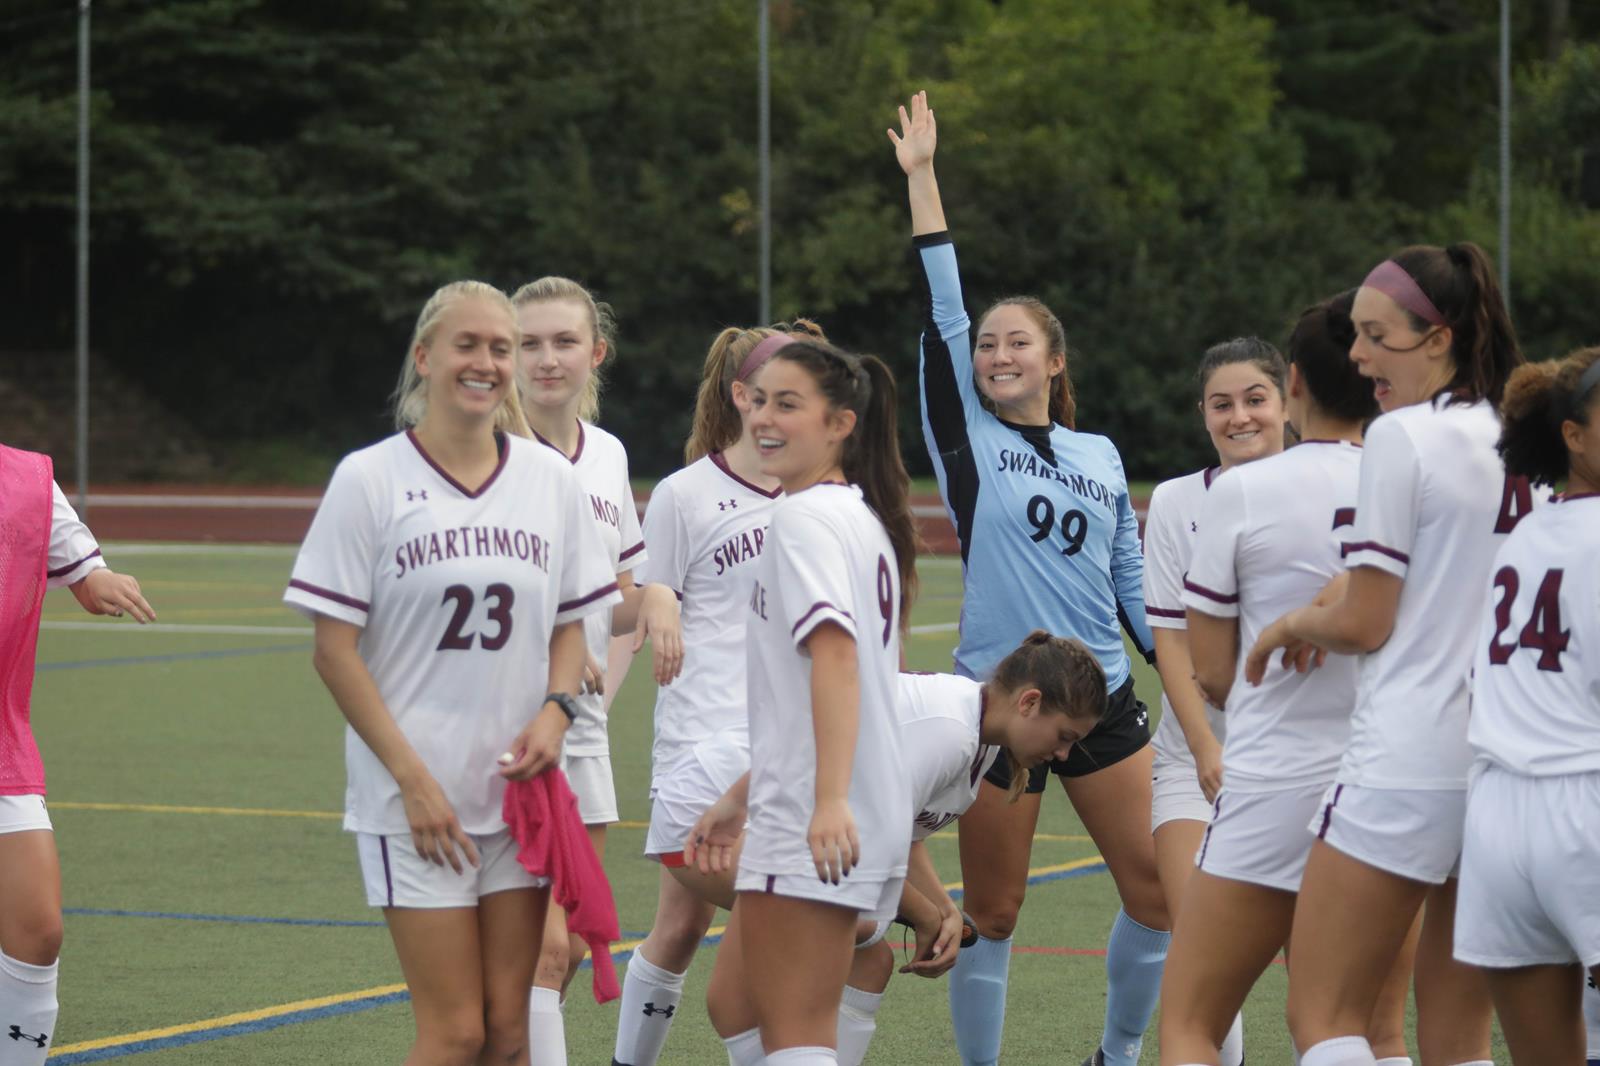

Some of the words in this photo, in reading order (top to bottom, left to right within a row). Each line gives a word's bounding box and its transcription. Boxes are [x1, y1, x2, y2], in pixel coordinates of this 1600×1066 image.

[395, 525, 550, 579] SWARTHMORE
[714, 526, 769, 576] SWAR
[1027, 494, 1088, 557] 99
[436, 582, 515, 652] 23
[877, 552, 893, 649] 9
[1489, 565, 1571, 673] 24
